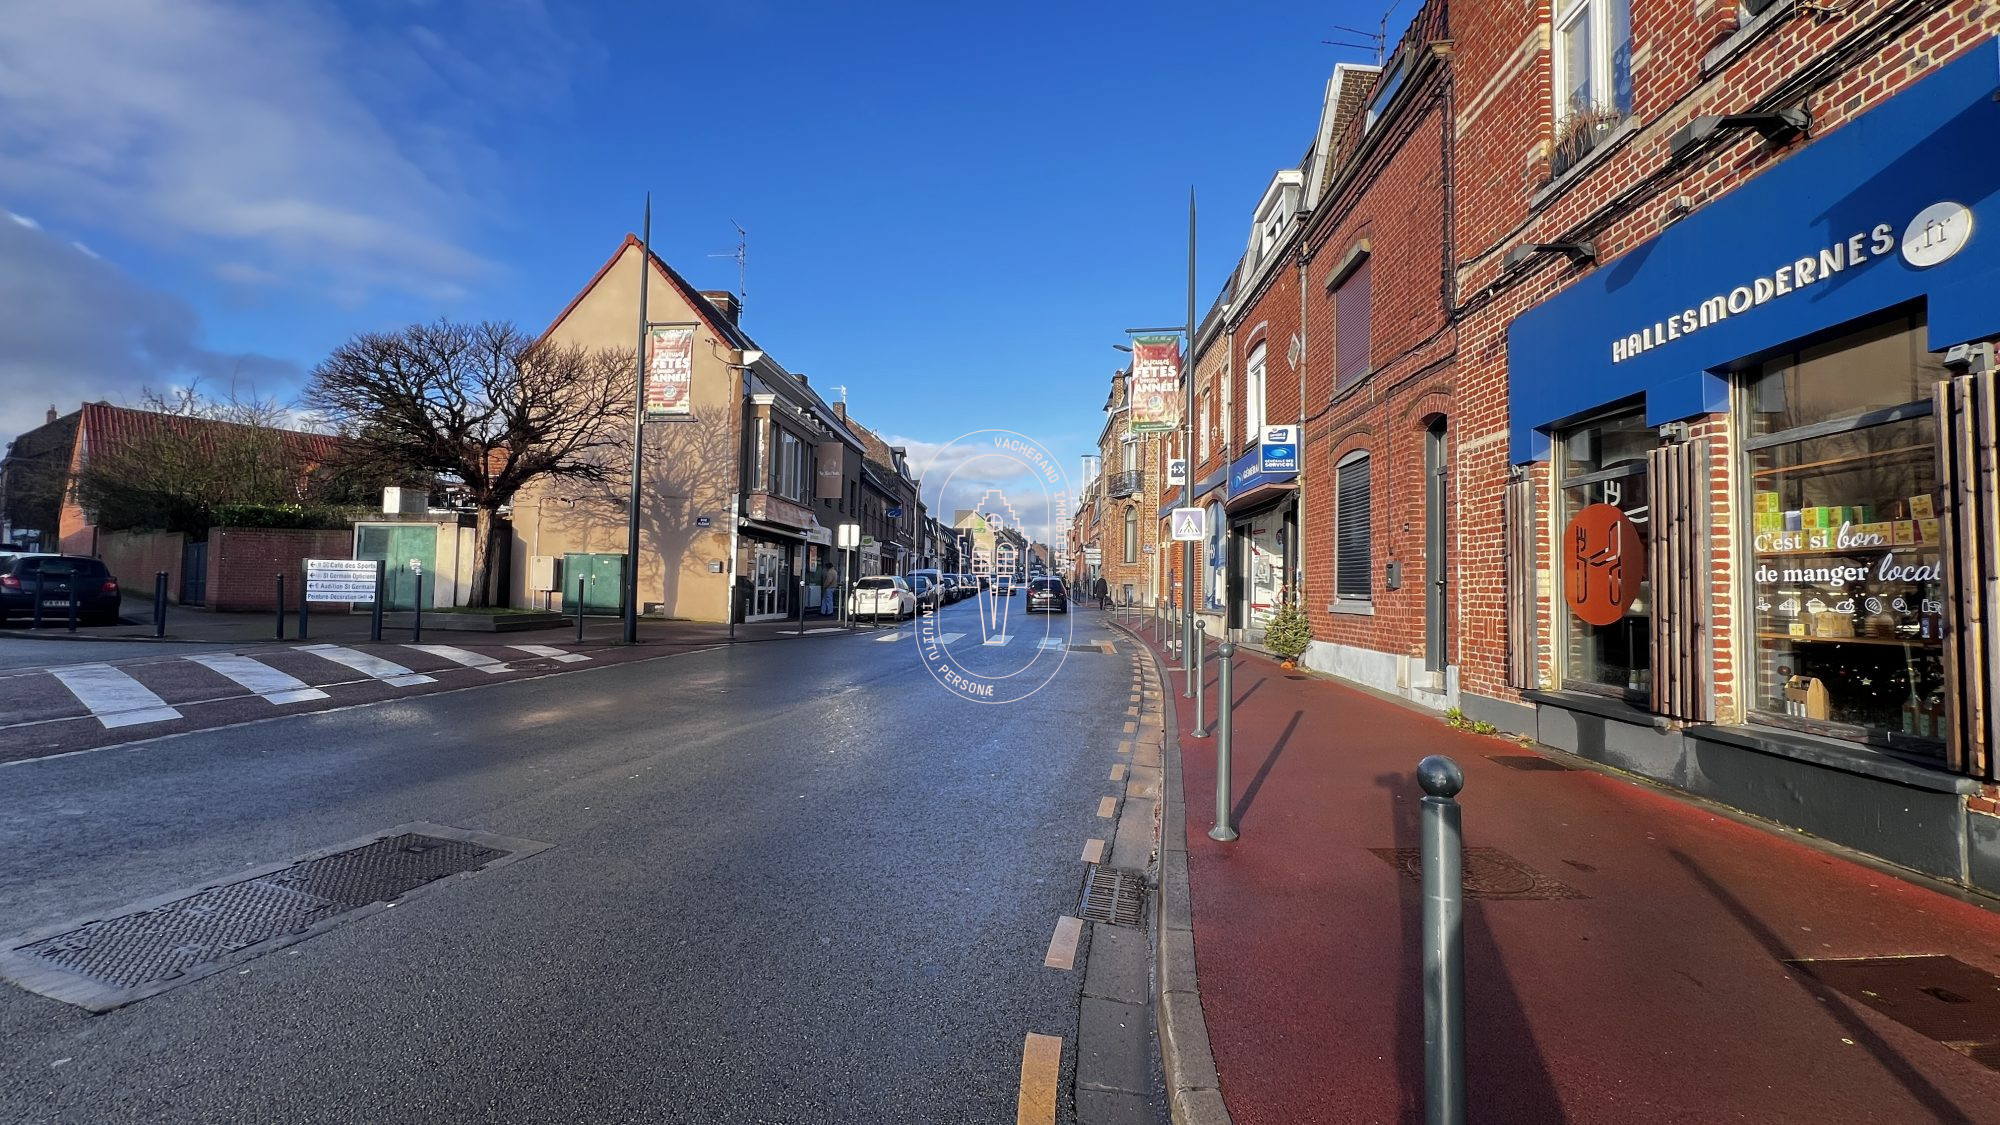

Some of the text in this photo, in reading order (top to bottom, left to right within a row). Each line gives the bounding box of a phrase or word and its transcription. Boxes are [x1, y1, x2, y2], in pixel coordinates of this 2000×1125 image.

[1612, 223, 1895, 364] HALLESMODERNES
[1810, 530, 1829, 549] si
[1837, 521, 1884, 549] bon
[357, 562, 376, 570] Sports
[1755, 565, 1778, 583] de
[1783, 565, 1869, 586] manger
